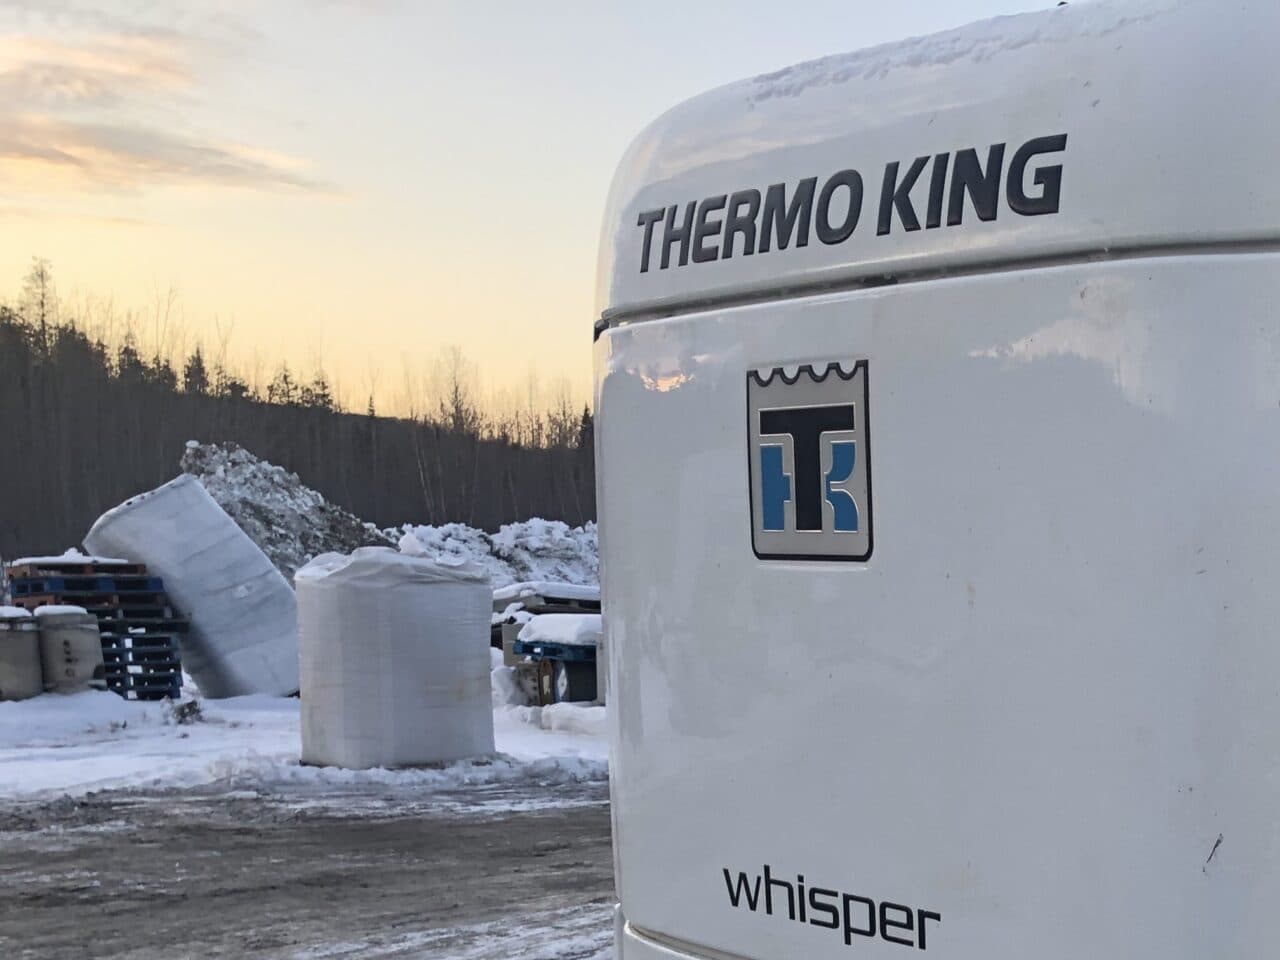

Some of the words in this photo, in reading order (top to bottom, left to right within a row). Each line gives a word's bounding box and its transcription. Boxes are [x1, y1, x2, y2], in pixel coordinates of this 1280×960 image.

[637, 169, 864, 273] THERMO
[876, 133, 1068, 237] KING
[722, 864, 941, 950] whisper
